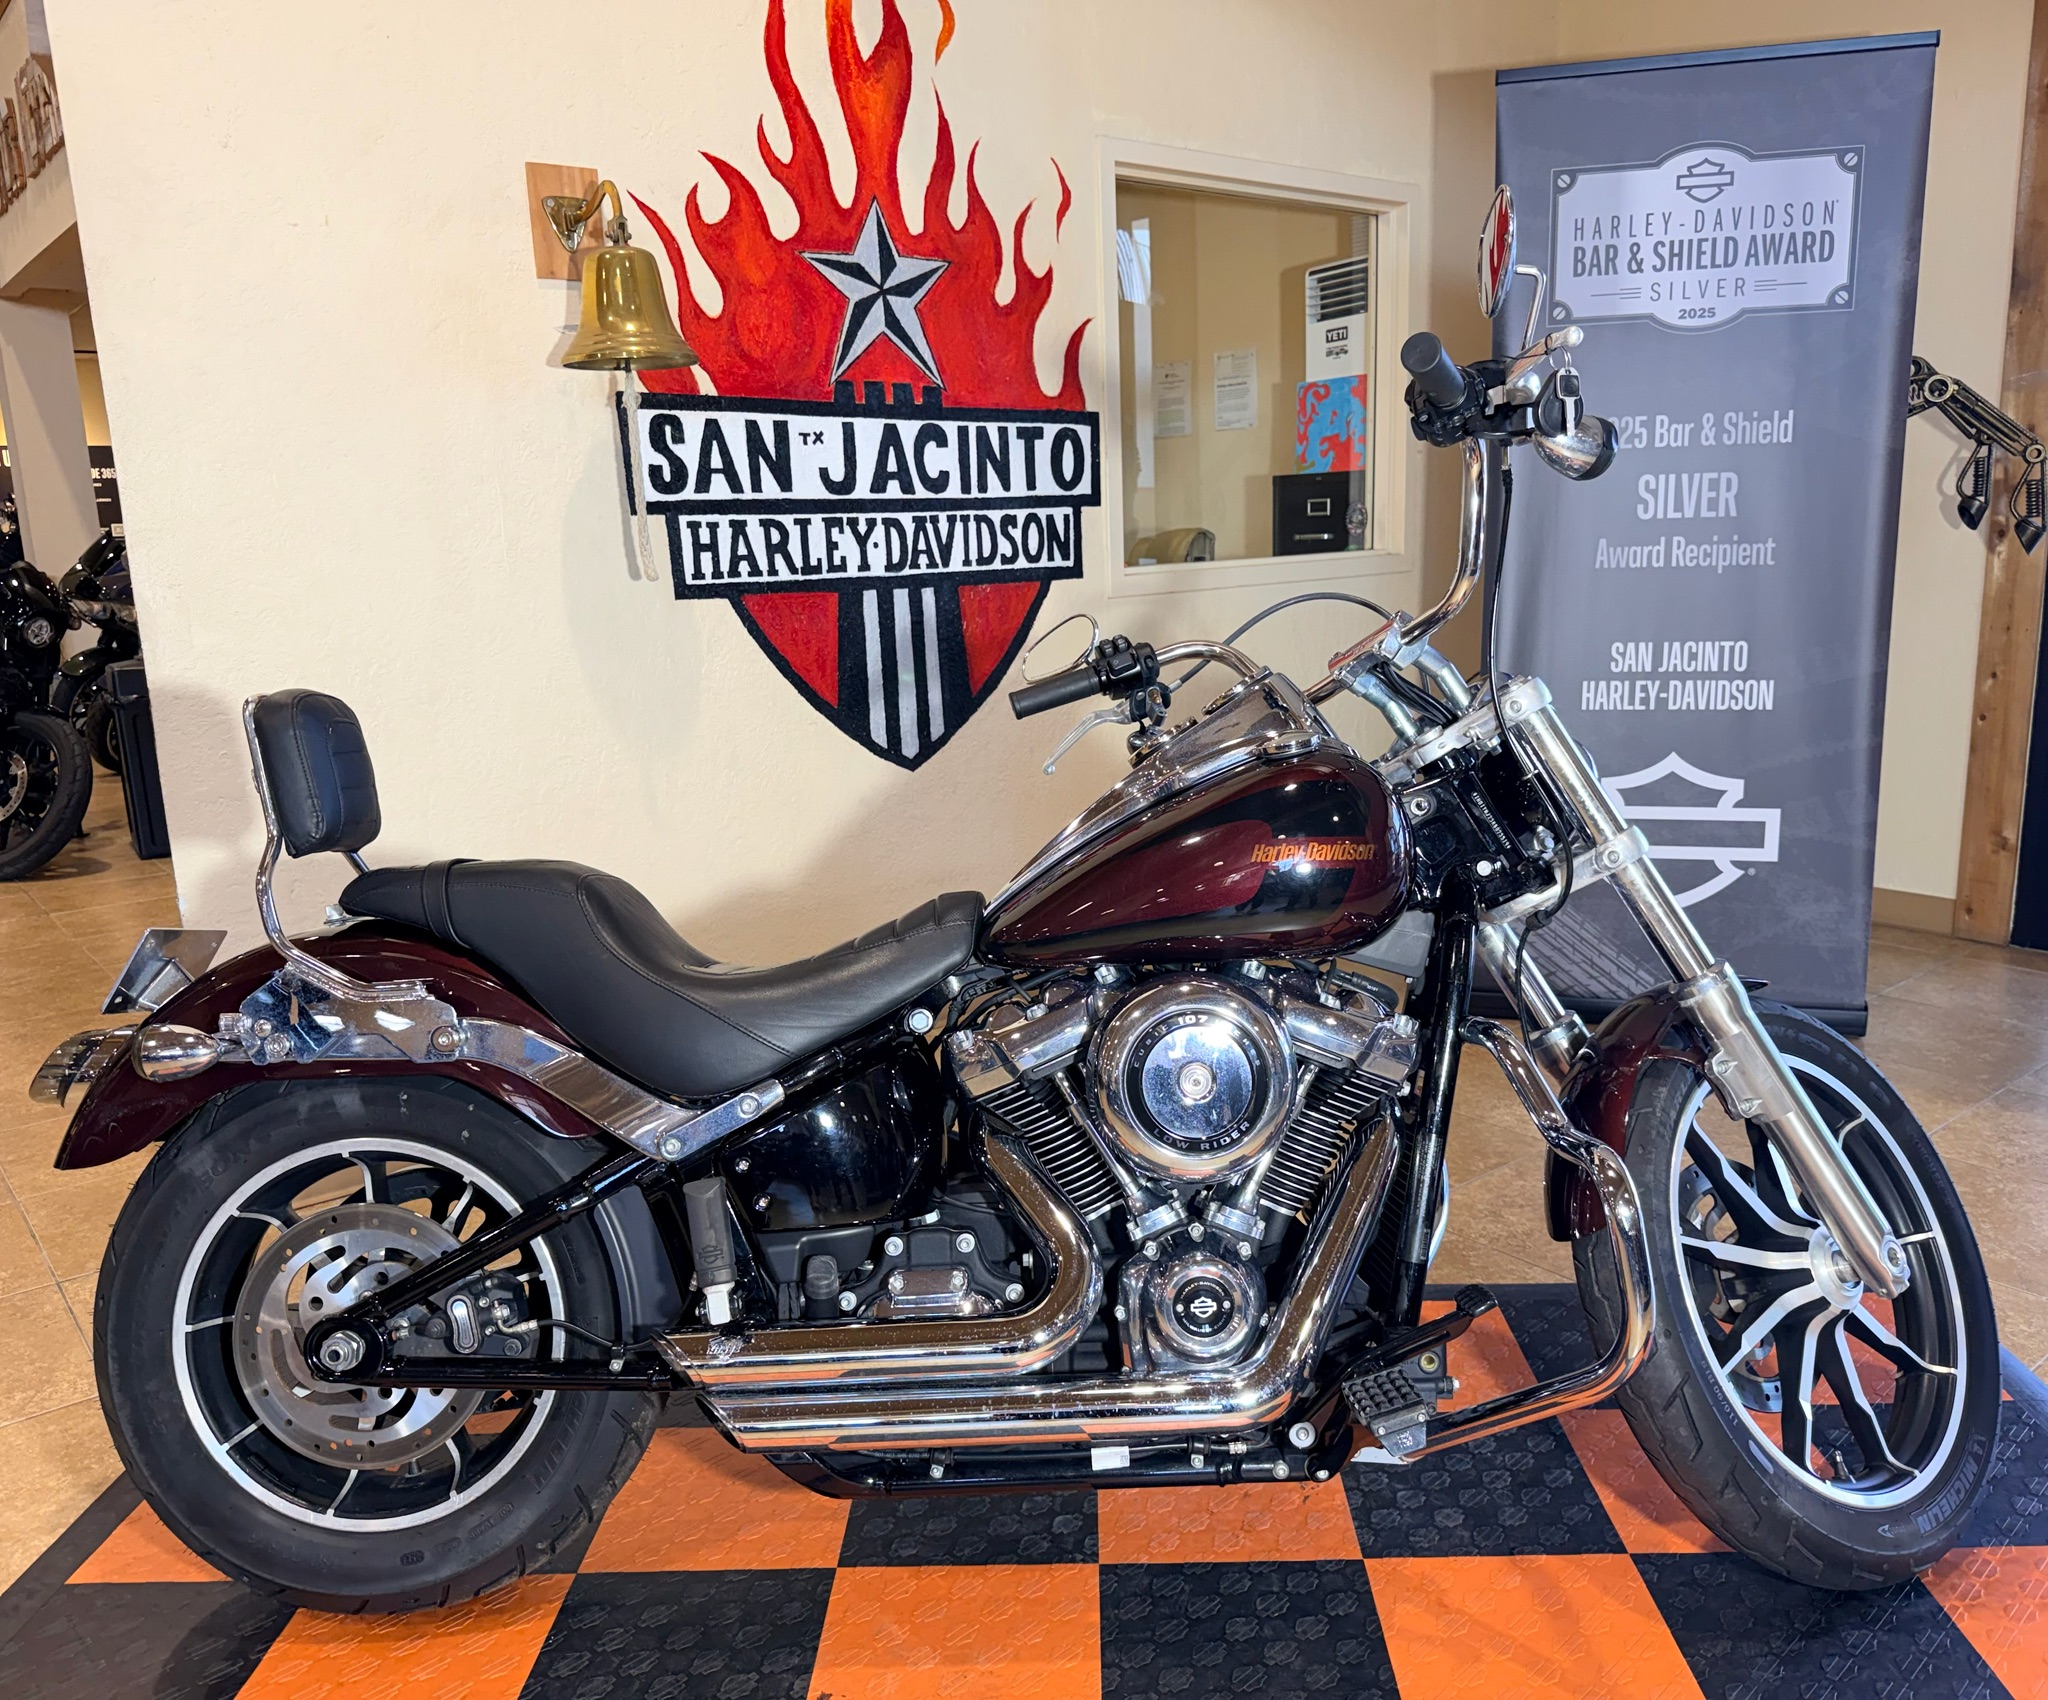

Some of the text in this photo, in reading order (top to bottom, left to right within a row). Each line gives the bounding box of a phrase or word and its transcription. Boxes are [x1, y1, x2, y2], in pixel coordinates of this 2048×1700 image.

[1573, 200, 1837, 242] HARLEY-DAVIDSON
[1572, 229, 1836, 277] BAR & SHIELD AWARD
[1650, 277, 1746, 302] SILVER
[1677, 306, 1717, 320] 2025
[1326, 328, 1347, 341] YETI
[1608, 409, 1795, 449] 25 Bar & Shield
[648, 412, 1085, 496] SAN TX JACINTO
[1636, 472, 1739, 520] SILVER
[1594, 535, 1777, 574] Award Recipient
[1610, 640, 1749, 673] SAN JACINTO
[1580, 679, 1775, 711] HARLEY-DAVIDSON
[1250, 842, 1375, 863] Harley-Davidson
[1177, 1014, 1210, 1025] 107
[1153, 1121, 1251, 1151] LOW RIDER
[1916, 1456, 1979, 1534] MICHELIN
